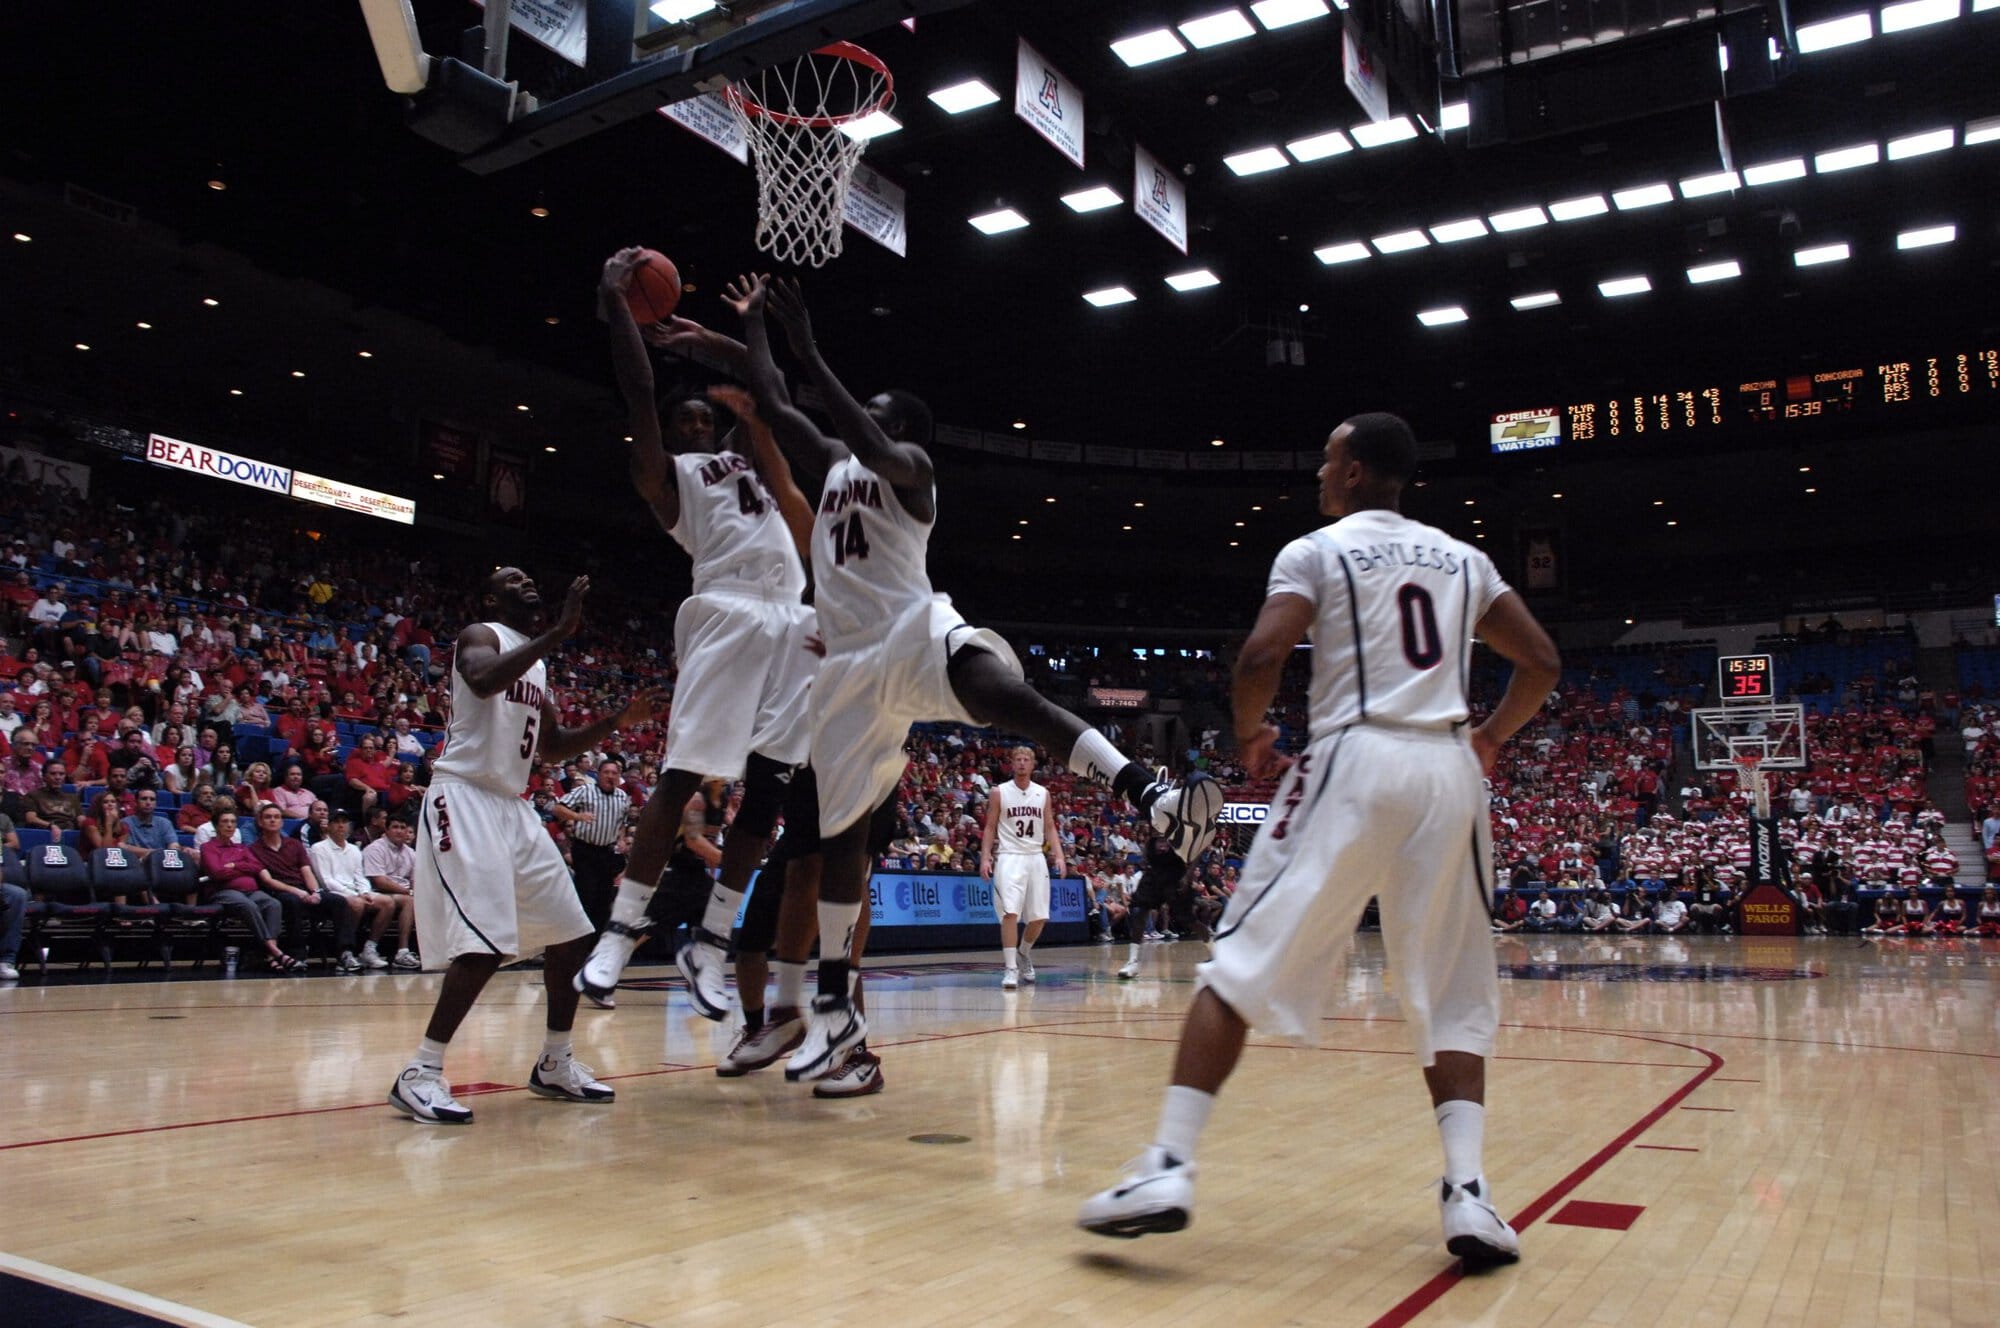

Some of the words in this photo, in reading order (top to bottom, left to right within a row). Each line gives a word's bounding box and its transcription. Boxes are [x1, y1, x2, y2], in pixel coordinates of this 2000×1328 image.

[1814, 368, 1864, 383] CONCORDIA
[1879, 362, 1910, 375] PLYR
[1884, 372, 1907, 384] PTS
[1928, 368, 1938, 377] 0
[1740, 380, 1777, 393] ARIZONA
[1842, 381, 1852, 394] 4
[1884, 382, 1909, 393] RBS
[1929, 377, 1939, 387] 0
[1958, 373, 1969, 383] 0
[1884, 391, 1910, 402] FLS
[1930, 386, 1940, 396] 0
[1959, 382, 1969, 393] 0
[1568, 403, 1595, 415] PLYR
[1609, 400, 1618, 409] 0
[1634, 397, 1643, 406] 5
[1653, 394, 1668, 405] 14
[1676, 391, 1693, 402] 34
[1702, 388, 1720, 398] 43
[1785, 400, 1822, 418] 15:39
[1496, 408, 1553, 423] O'RIELLY
[1572, 421, 1594, 432] RBS
[1635, 415, 1644, 424] 0
[1685, 409, 1695, 418] 0
[1573, 413, 1592, 423] PTS
[1610, 409, 1619, 418] 0
[1573, 430, 1595, 440] FLS
[1610, 426, 1620, 436] 0
[1635, 423, 1645, 433] 0
[1661, 420, 1670, 430] 0
[1686, 417, 1696, 427] 0
[1712, 414, 1722, 424] 0
[1497, 437, 1556, 452] WATSON
[830, 511, 869, 566] 14
[1347, 542, 1459, 576] BAYLESS
[1396, 582, 1443, 671] 0
[1729, 659, 1766, 672] 15:39
[1732, 674, 1761, 695] 35
[520, 715, 536, 760] 5
[1270, 754, 1312, 841] CATS
[1007, 806, 1042, 819] ARIZONA
[1217, 806, 1269, 821] EICO
[433, 794, 452, 852] CATS
[1016, 819, 1034, 838] 34
[1757, 822, 1771, 880] ARIZONA
[1743, 904, 1791, 914] WELLS
[1746, 914, 1790, 924] FARGO
